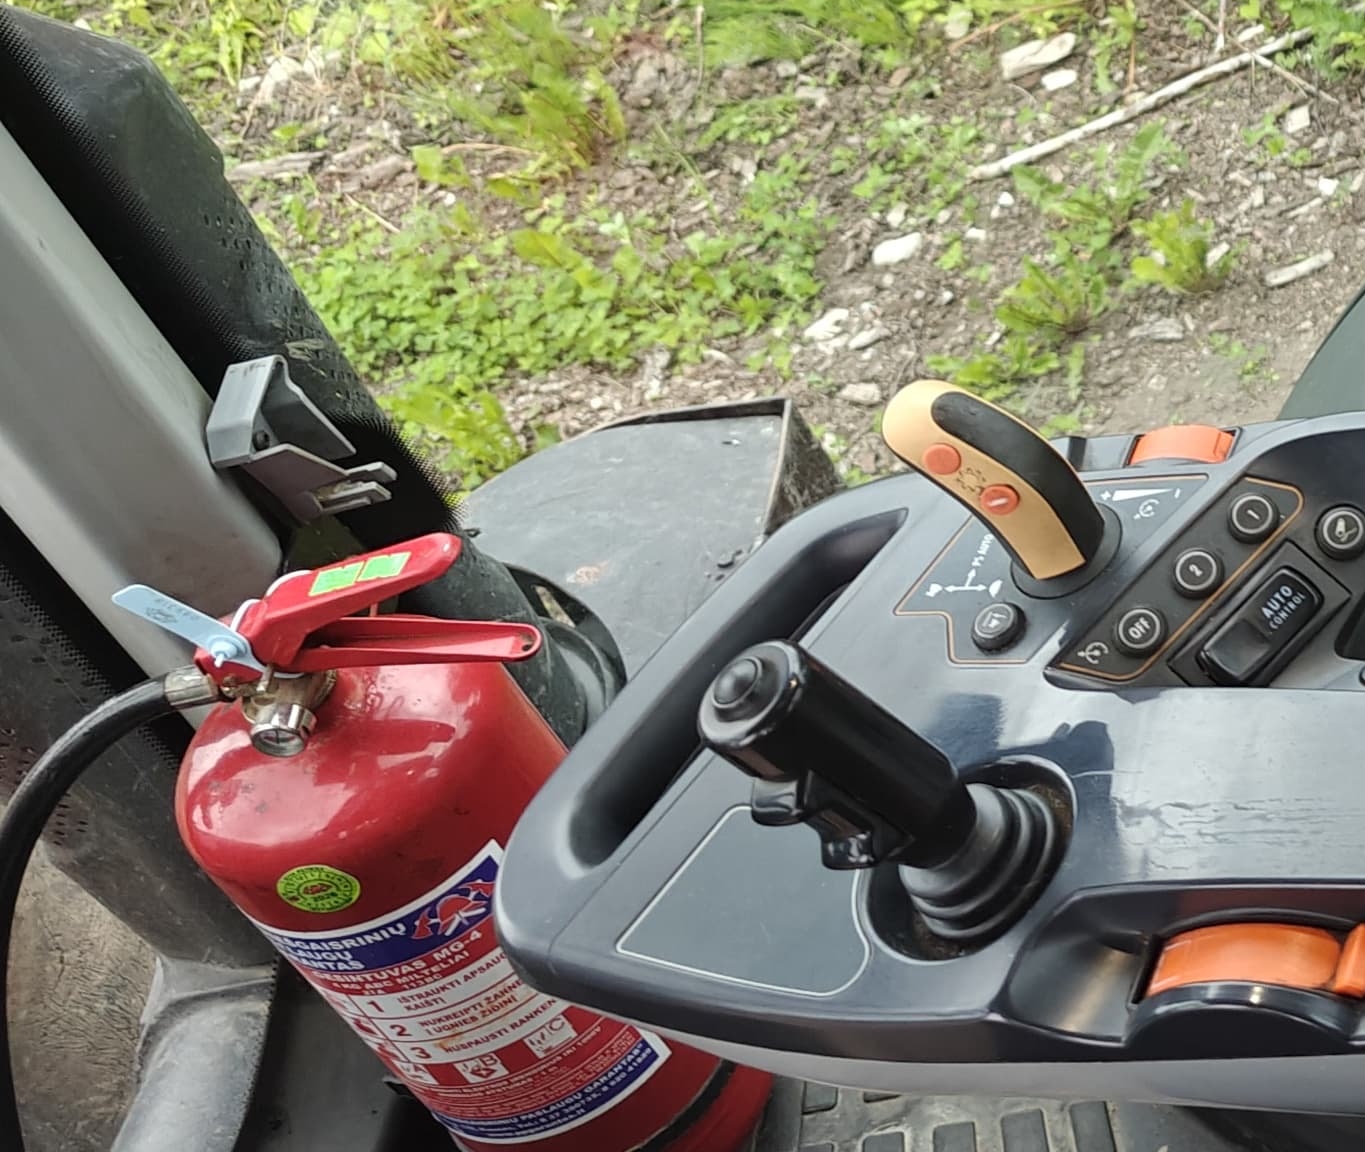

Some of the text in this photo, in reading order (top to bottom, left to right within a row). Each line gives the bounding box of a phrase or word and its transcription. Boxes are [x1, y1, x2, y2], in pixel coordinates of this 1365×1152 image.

[1188, 564, 1203, 577] 2
[1260, 585, 1293, 619] AUTO
[1268, 592, 1306, 630] CONTROL
[1128, 617, 1152, 639] OFF
[433, 929, 483, 962] MG-4
[367, 1000, 385, 1013] 1
[389, 1023, 413, 1038] 2
[409, 1046, 433, 1060] 3
